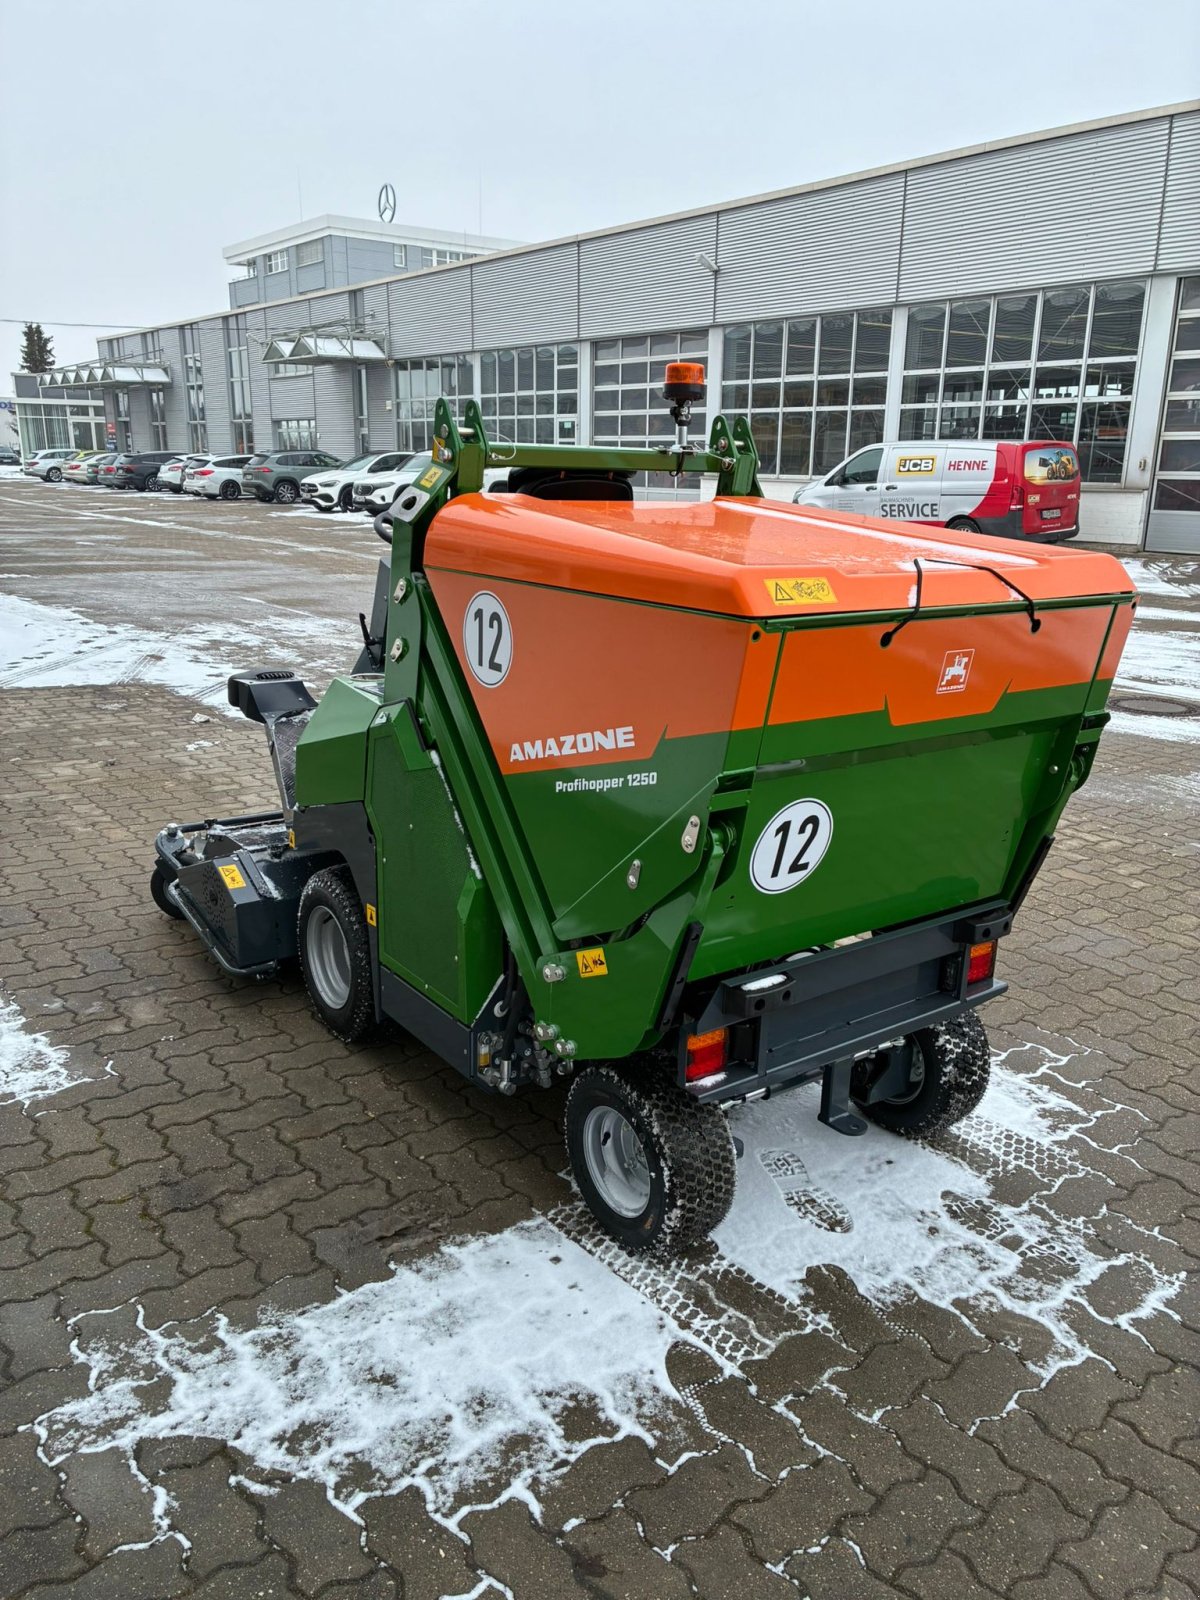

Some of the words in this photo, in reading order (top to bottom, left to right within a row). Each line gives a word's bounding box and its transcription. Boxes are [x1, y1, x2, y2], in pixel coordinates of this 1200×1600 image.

[898, 459, 934, 472] JCB
[947, 460, 989, 471] HENNE
[881, 503, 939, 518] SERVICE
[474, 607, 503, 673] 12
[510, 725, 636, 763] AMAZONE
[555, 777, 625, 793] Profihopper
[626, 771, 658, 787] 1250
[770, 814, 820, 879] 12
